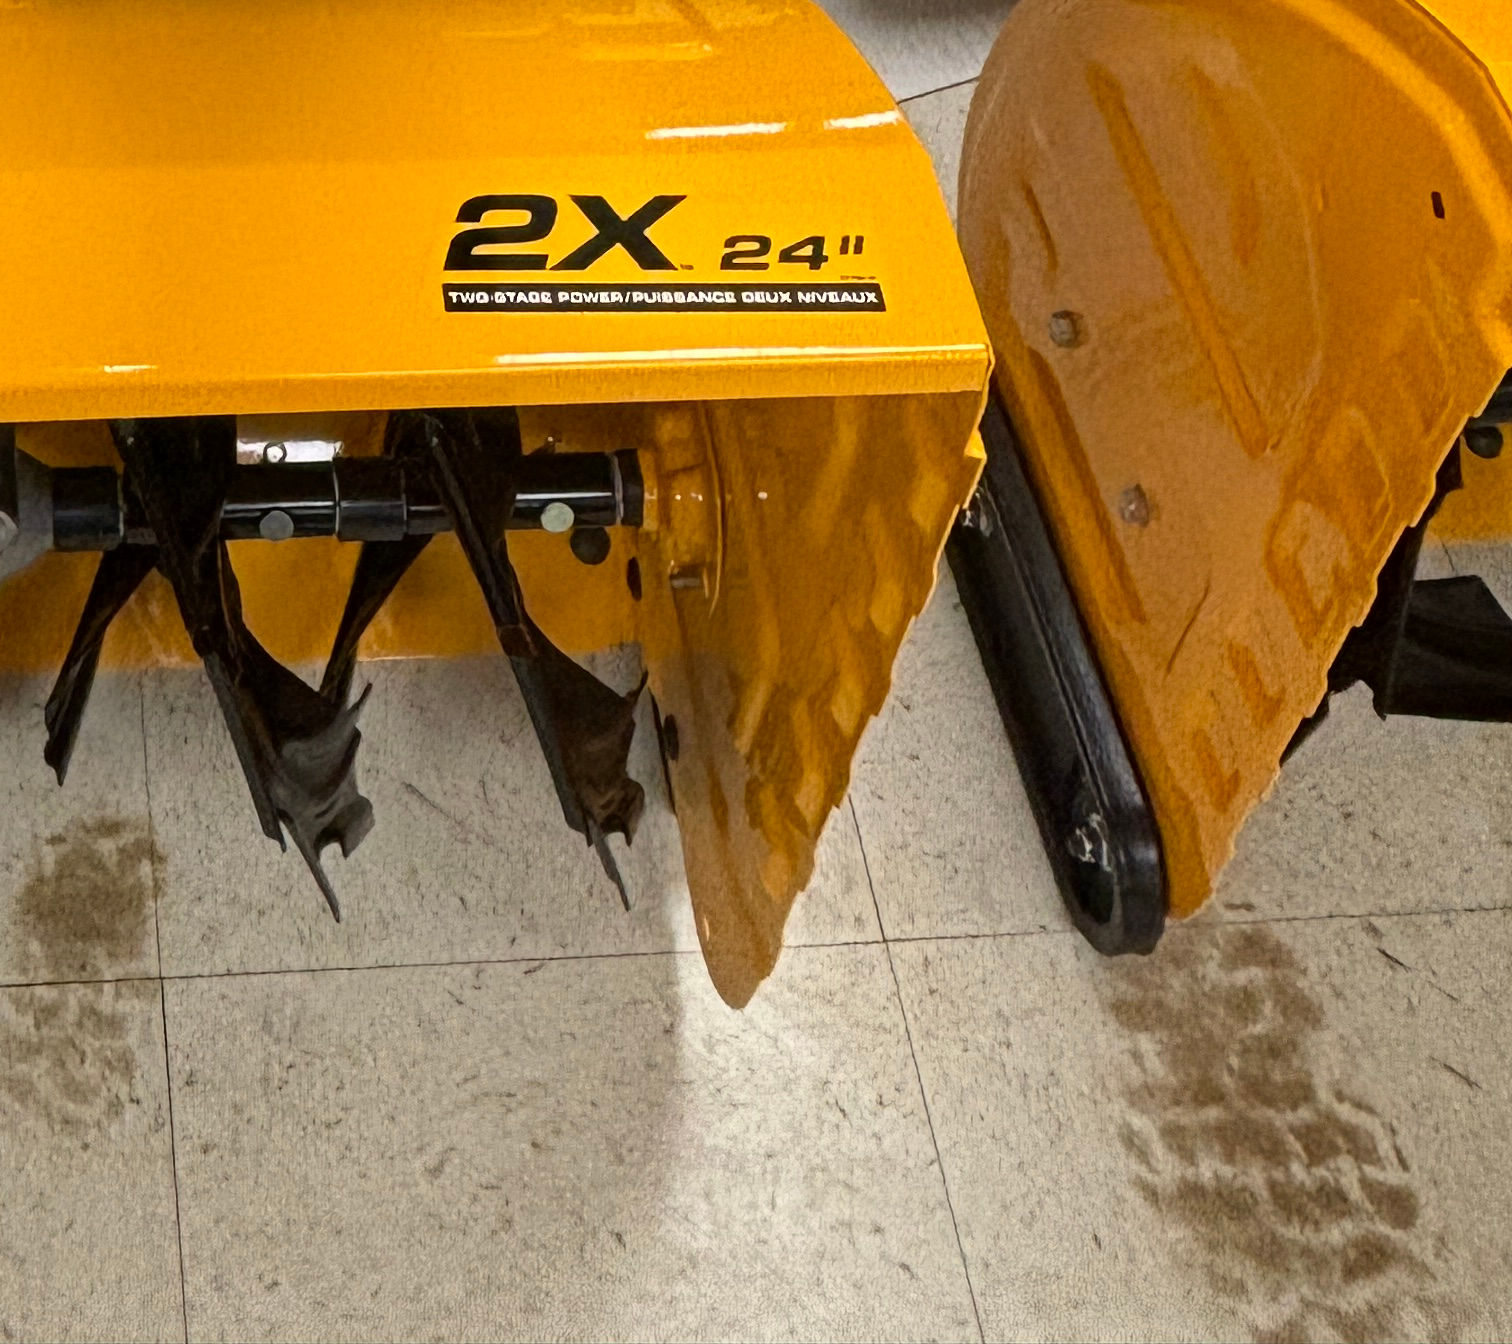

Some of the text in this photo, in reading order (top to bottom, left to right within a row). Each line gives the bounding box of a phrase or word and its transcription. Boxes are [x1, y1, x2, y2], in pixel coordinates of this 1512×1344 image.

[444, 194, 864, 271] 2X 24"
[449, 289, 553, 304] TWO-STAGE
[742, 289, 792, 304] DEUX
[797, 289, 879, 304] NIVEAUX
